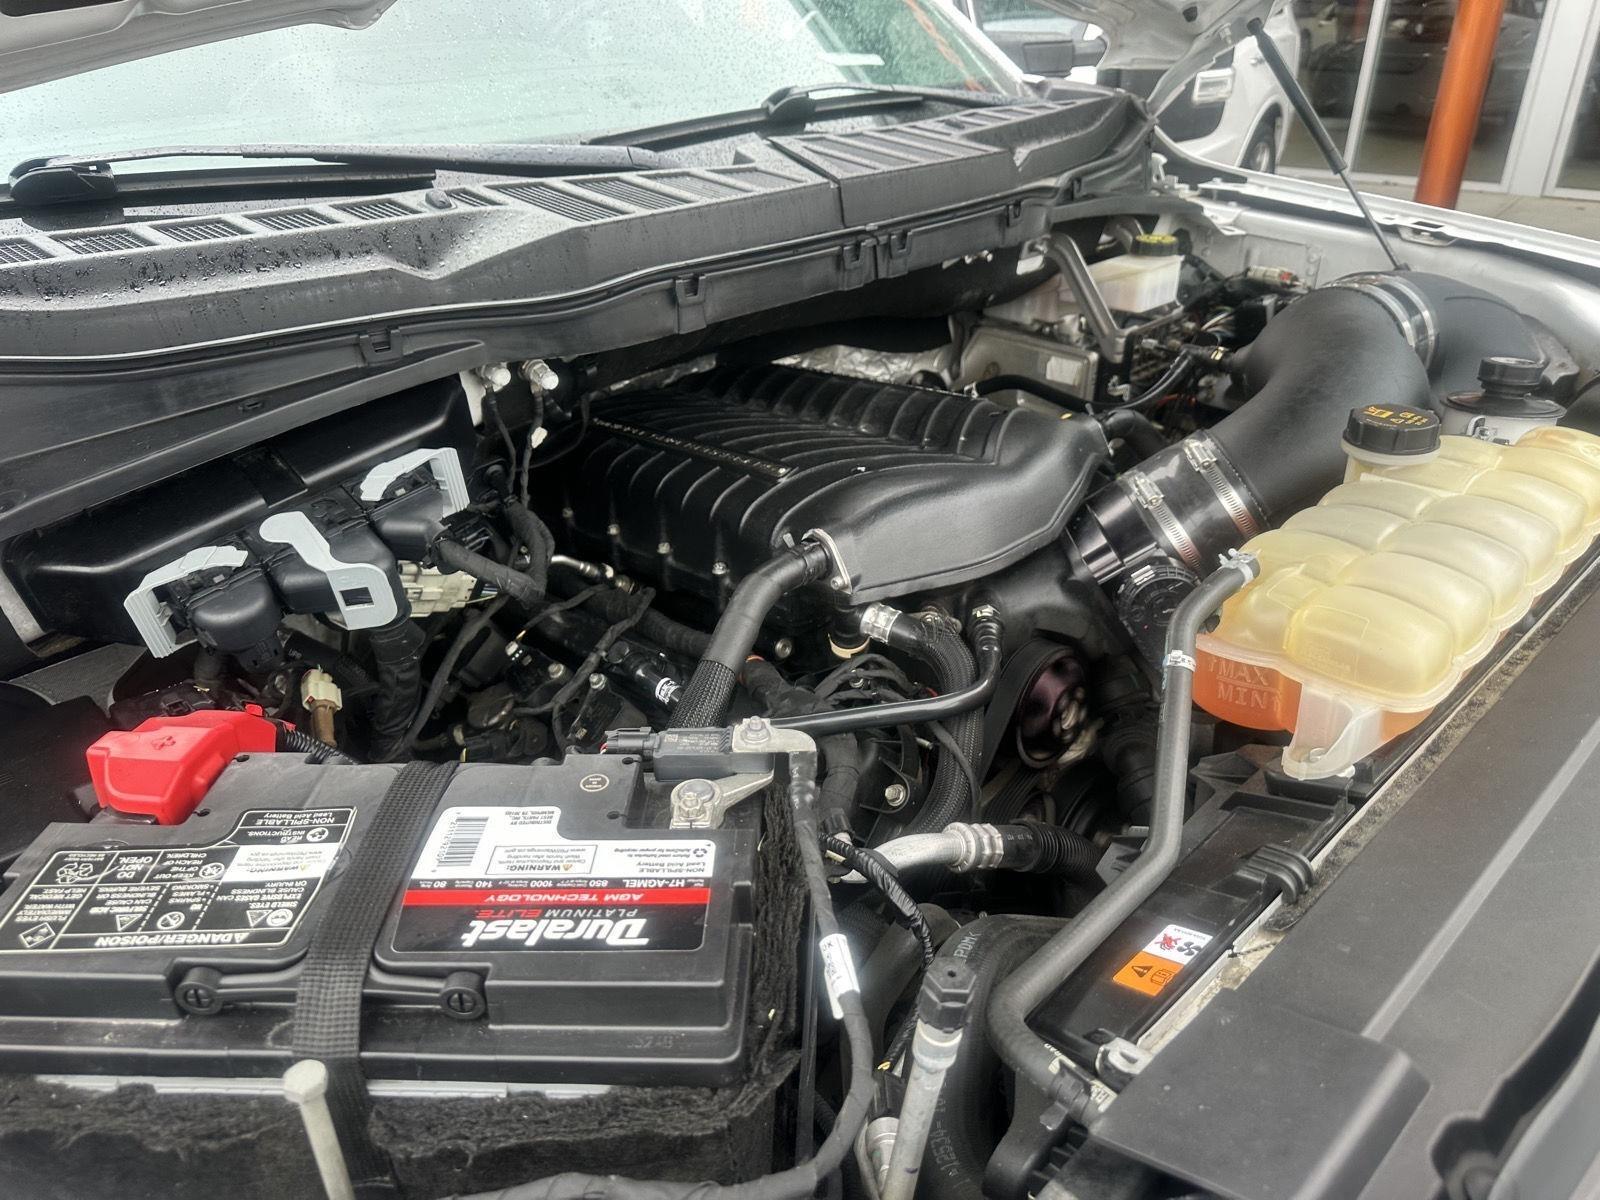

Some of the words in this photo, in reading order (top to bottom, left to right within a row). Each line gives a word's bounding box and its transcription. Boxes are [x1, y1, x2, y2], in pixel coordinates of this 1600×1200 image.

[1218, 662, 1269, 686] MAX
[1217, 682, 1266, 709] MIN
[264, 812, 293, 820] Battery
[254, 817, 334, 826] NON-SPILLABLE
[433, 880, 447, 888] 80
[475, 880, 493, 888] 140
[622, 879, 685, 888] H7-AGMEL
[483, 893, 598, 902] TECHNOLOGY
[604, 893, 644, 901] AGM
[476, 909, 542, 918] ELITE
[545, 909, 638, 918] PLATINUM
[461, 919, 649, 947] Duralast
[94, 933, 233, 946] DANGER/POISON
